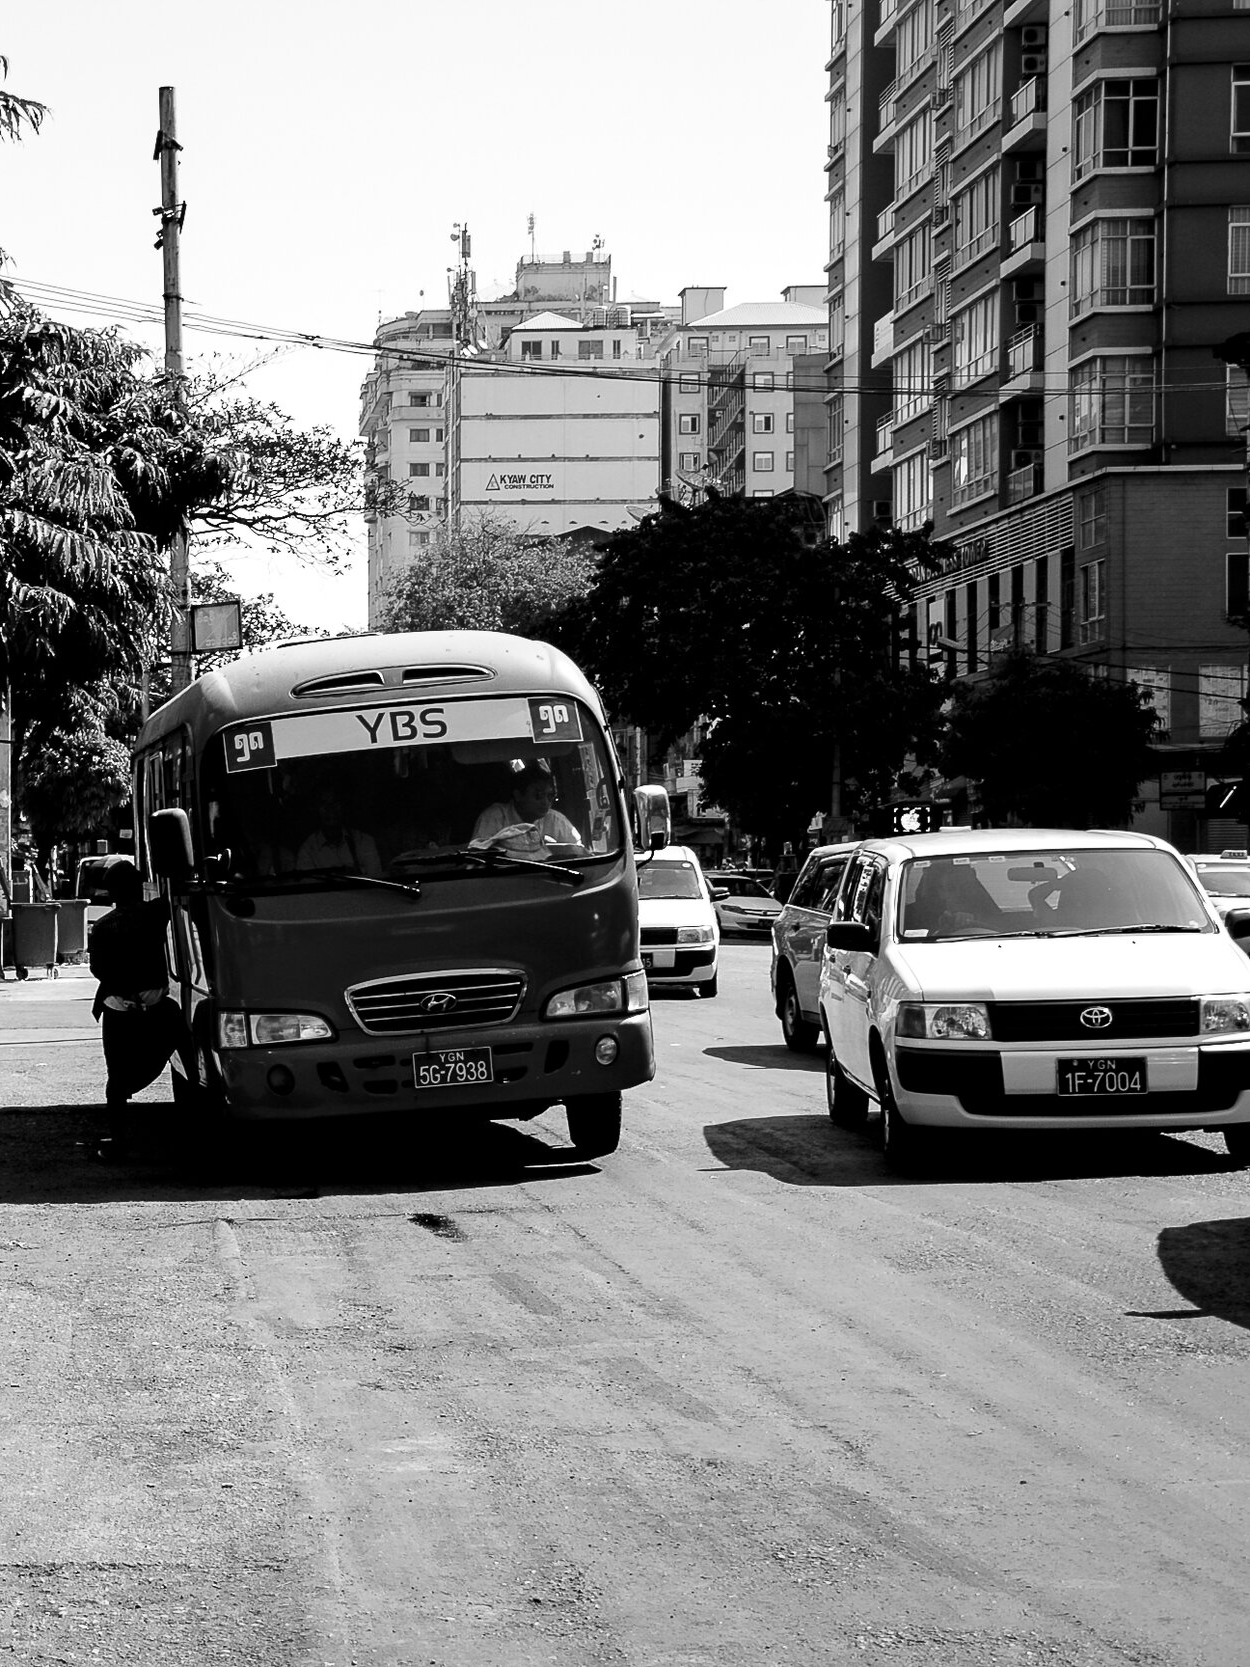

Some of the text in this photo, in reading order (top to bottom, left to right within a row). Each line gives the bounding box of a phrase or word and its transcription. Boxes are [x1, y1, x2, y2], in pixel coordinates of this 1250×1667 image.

[500, 474, 552, 484] KYAW CITY
[355, 707, 448, 744] YBS
[439, 1051, 464, 1063] YGN
[1087, 1060, 1116, 1070] YGN
[420, 1060, 488, 1085] 5G-7938
[1065, 1071, 1141, 1093] 1F-7004
